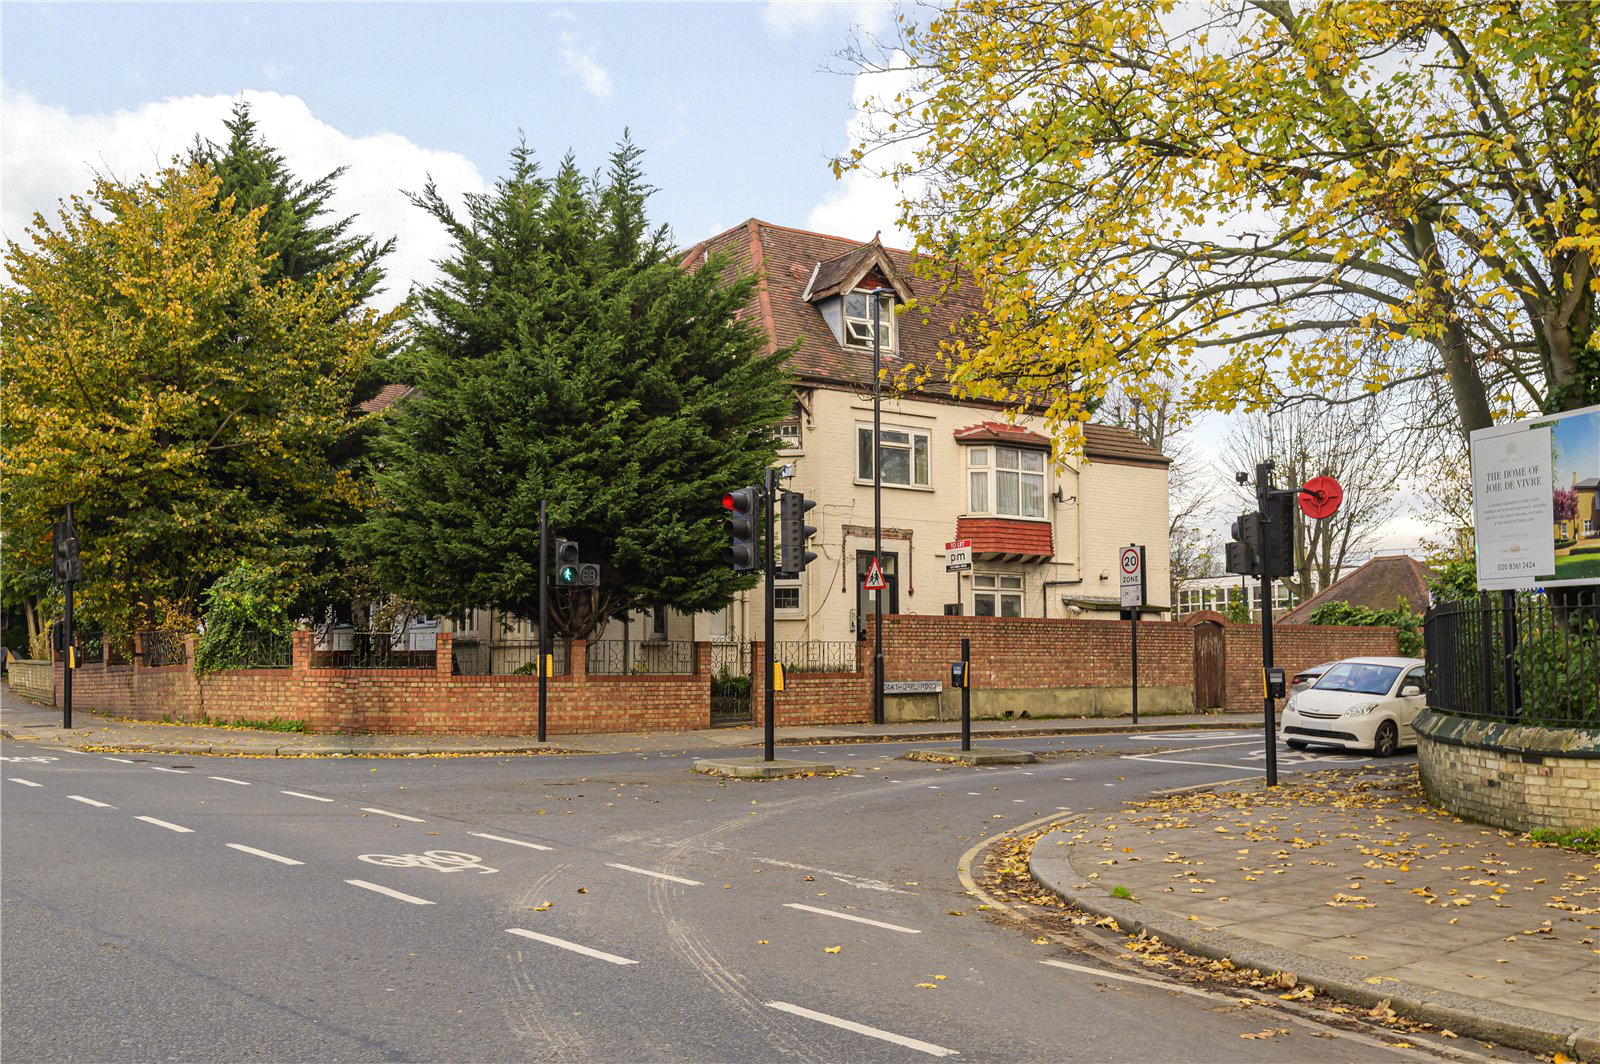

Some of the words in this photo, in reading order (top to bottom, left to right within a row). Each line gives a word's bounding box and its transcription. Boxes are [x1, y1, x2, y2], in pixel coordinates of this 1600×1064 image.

[1486, 471, 1501, 481] THE
[1503, 467, 1526, 479] HOME
[1528, 465, 1540, 475] OF
[1485, 483, 1502, 493] JOIE
[1504, 481, 1515, 490] DE
[1516, 476, 1542, 488] VIVRE
[1124, 556, 1136, 566] 20
[1497, 563, 1508, 571] 020
[1522, 561, 1536, 569] 2424
